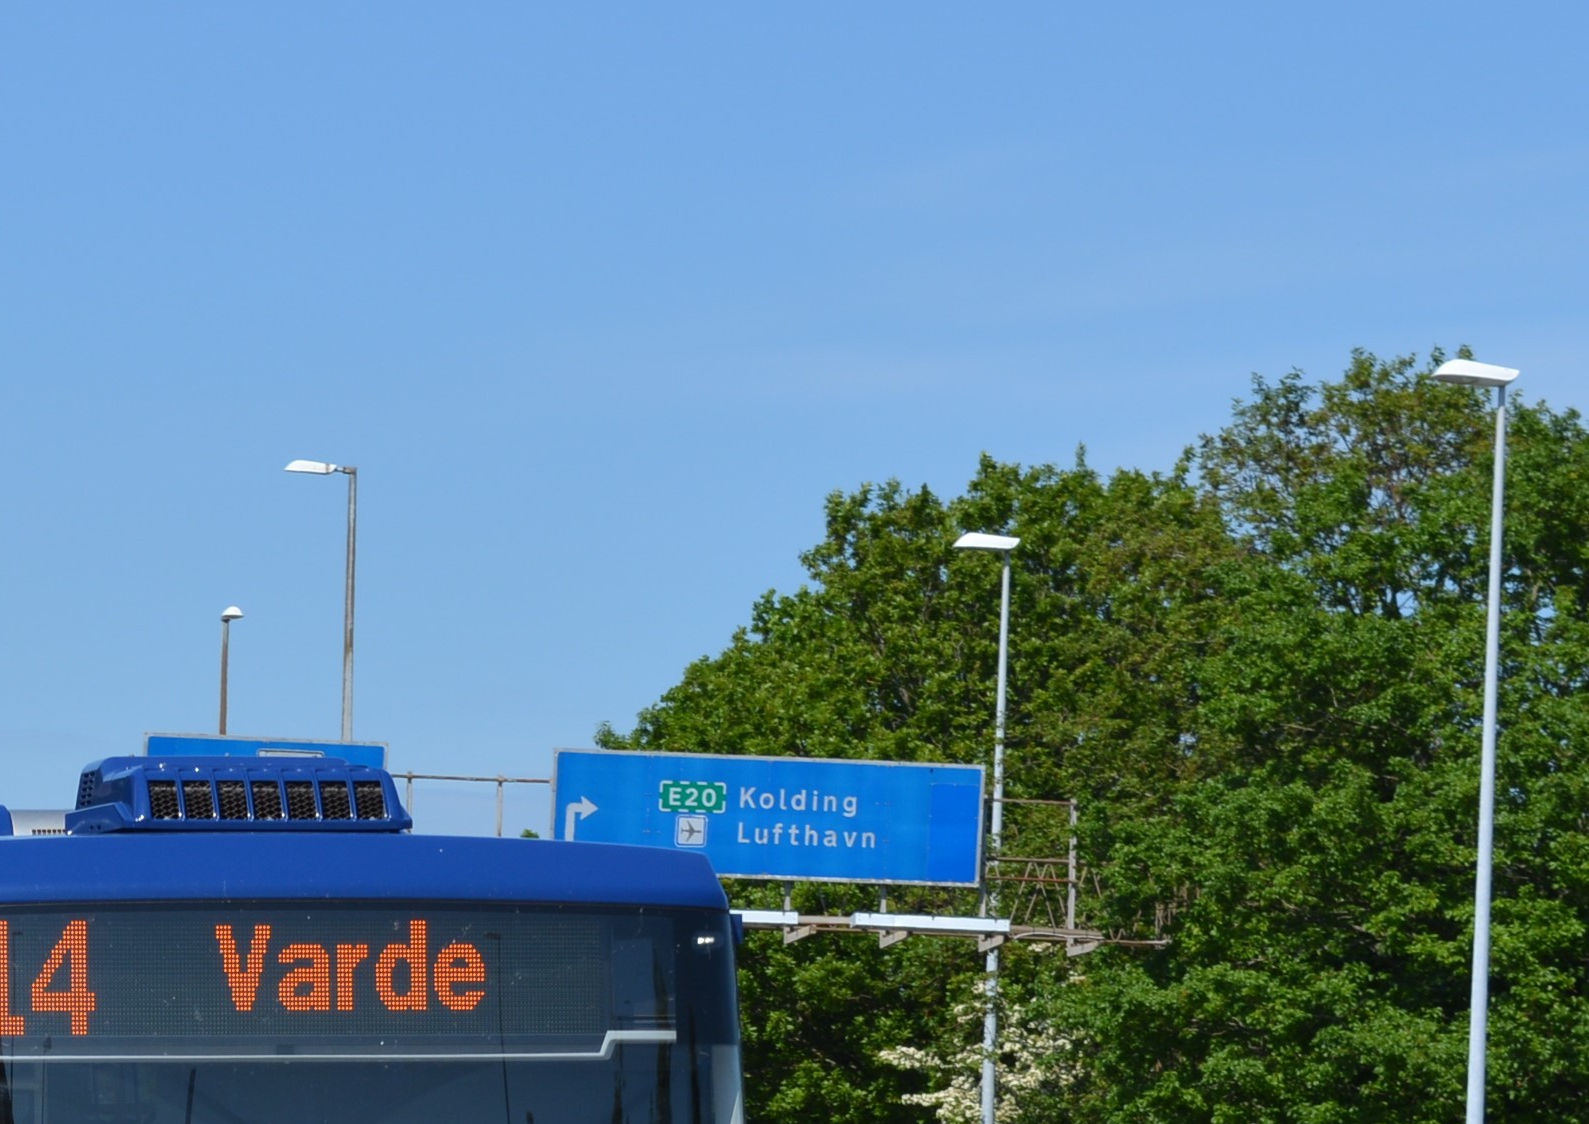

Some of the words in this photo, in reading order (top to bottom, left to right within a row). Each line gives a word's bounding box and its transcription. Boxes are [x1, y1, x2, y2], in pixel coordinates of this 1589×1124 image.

[668, 789, 717, 807] E20
[740, 787, 858, 817] Kolding
[737, 823, 876, 849] Lufthavn
[215, 920, 485, 1011] Varde
